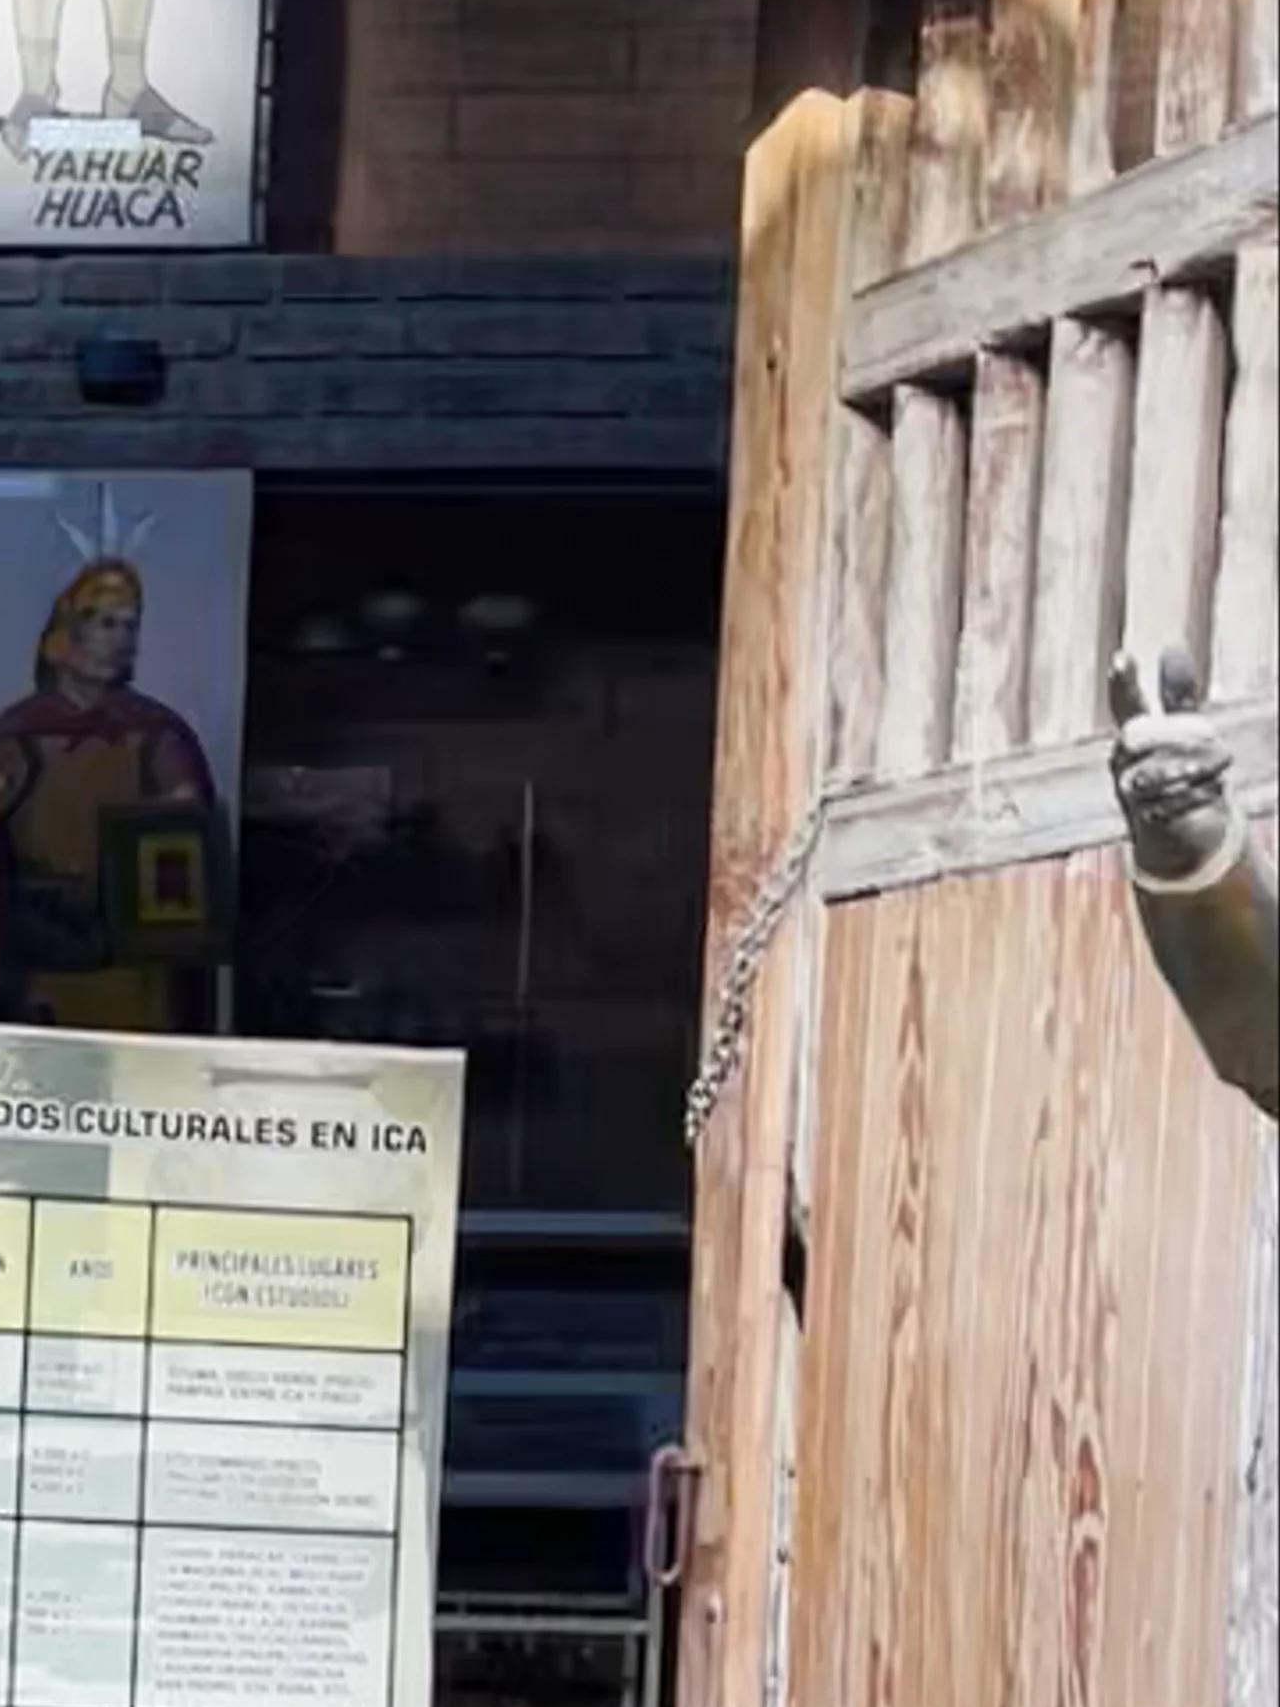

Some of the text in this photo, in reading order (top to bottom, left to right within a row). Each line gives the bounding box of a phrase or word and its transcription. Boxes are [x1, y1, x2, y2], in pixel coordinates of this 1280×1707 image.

[31, 149, 203, 189] YAHUAR
[34, 189, 185, 228] HUACA
[74, 1105, 297, 1147] CULTURALES
[310, 1120, 357, 1150] EN
[371, 1123, 428, 1154] ICA
